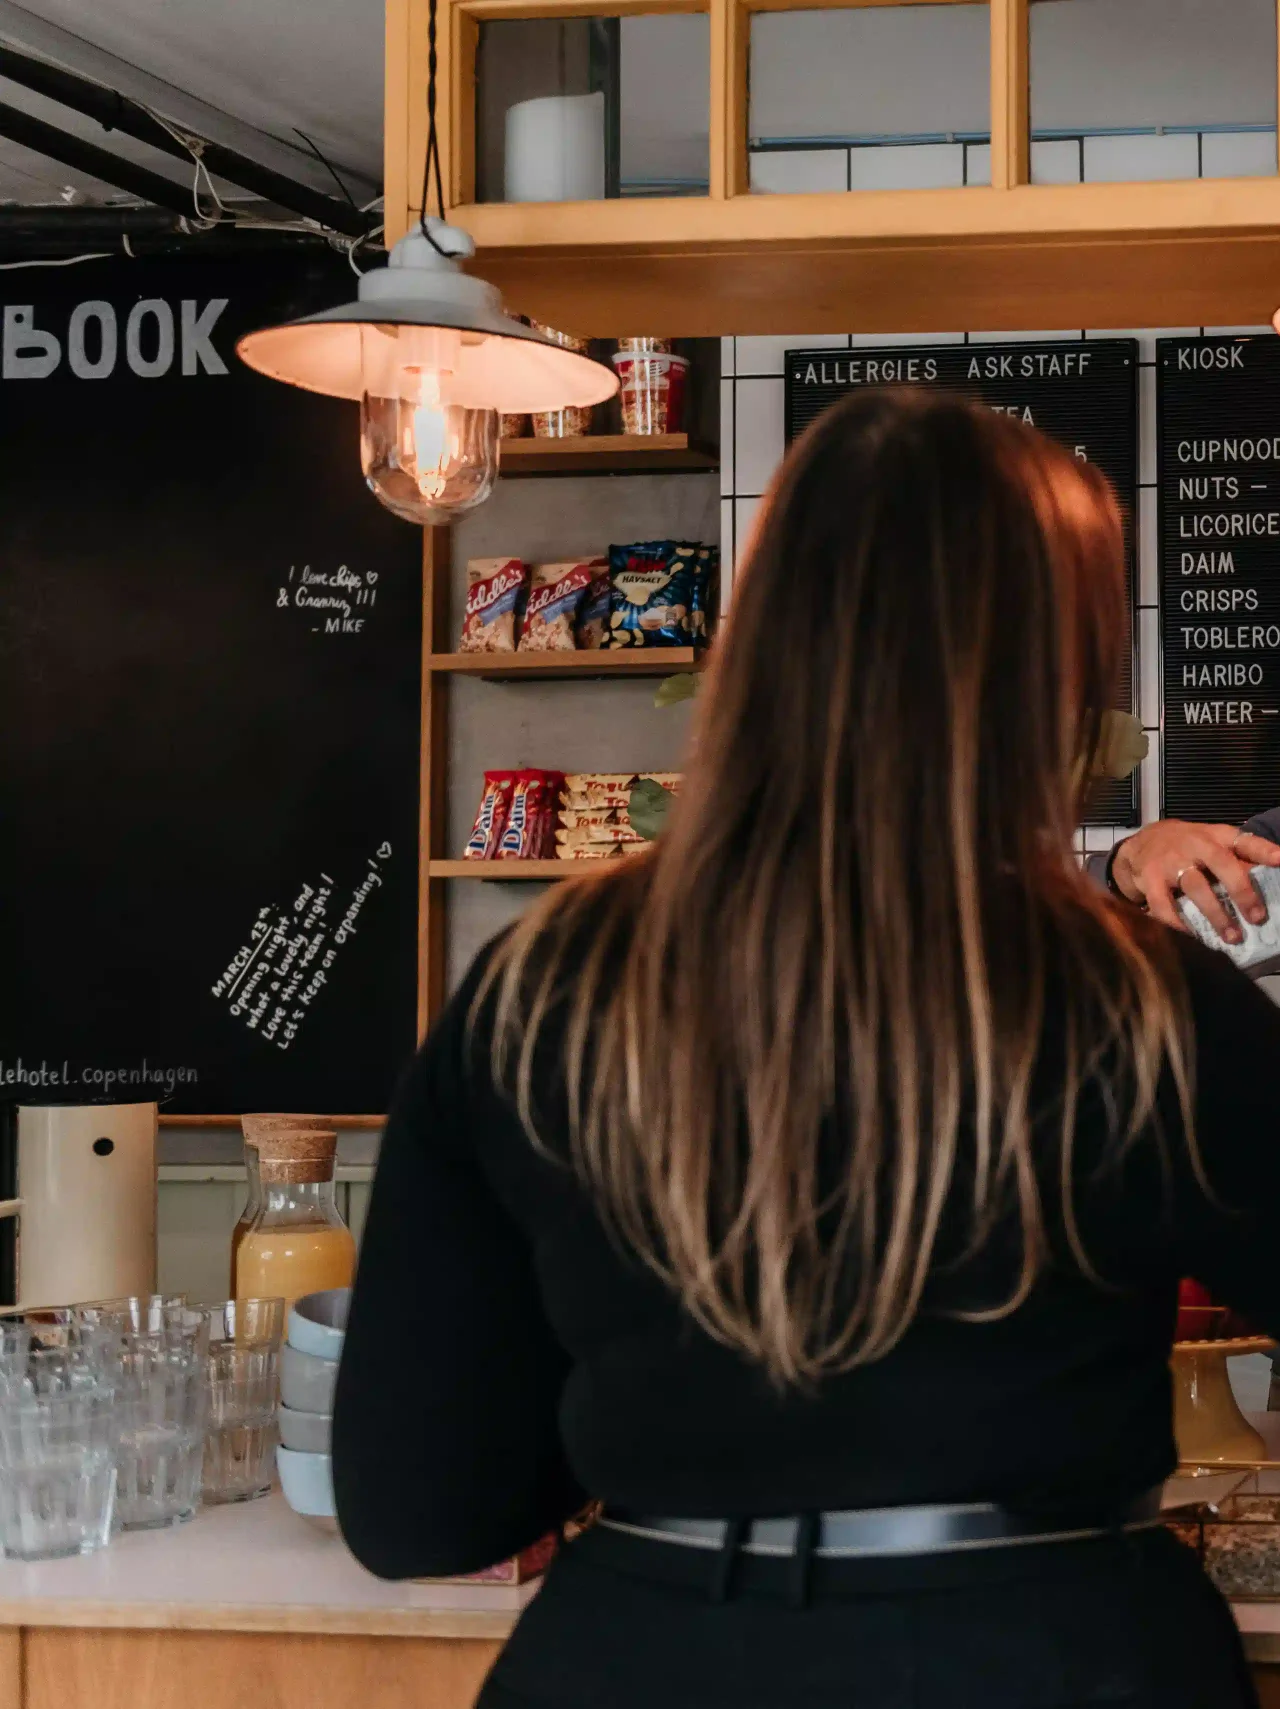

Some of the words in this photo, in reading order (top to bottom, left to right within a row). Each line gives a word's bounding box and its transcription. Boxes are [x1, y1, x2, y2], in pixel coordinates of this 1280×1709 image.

[3, 299, 230, 379] BOOK
[804, 358, 938, 385] ALLERGIES
[967, 355, 1014, 379] ASK
[1021, 353, 1092, 377] STAFF
[1177, 346, 1245, 370] KIOSK
[1179, 477, 1240, 500] NUTS
[1180, 512, 1280, 538] LICORICE
[1181, 551, 1236, 575] DAIM
[276, 587, 289, 608] &
[1180, 588, 1259, 612] CRISPS
[324, 617, 365, 634] MIKE
[1183, 663, 1264, 687] HARIBO
[1184, 701, 1253, 725] WATER
[229, 962, 270, 1016] Opening
[294, 883, 315, 911] and
[273, 933, 309, 977] lovely
[211, 946, 252, 998] MARCH
[298, 969, 328, 1006] keep
[322, 949, 337, 969] on
[270, 981, 281, 991] a
[246, 991, 271, 1029] what
[261, 1006, 287, 1041] Love
[280, 970, 304, 1002] this
